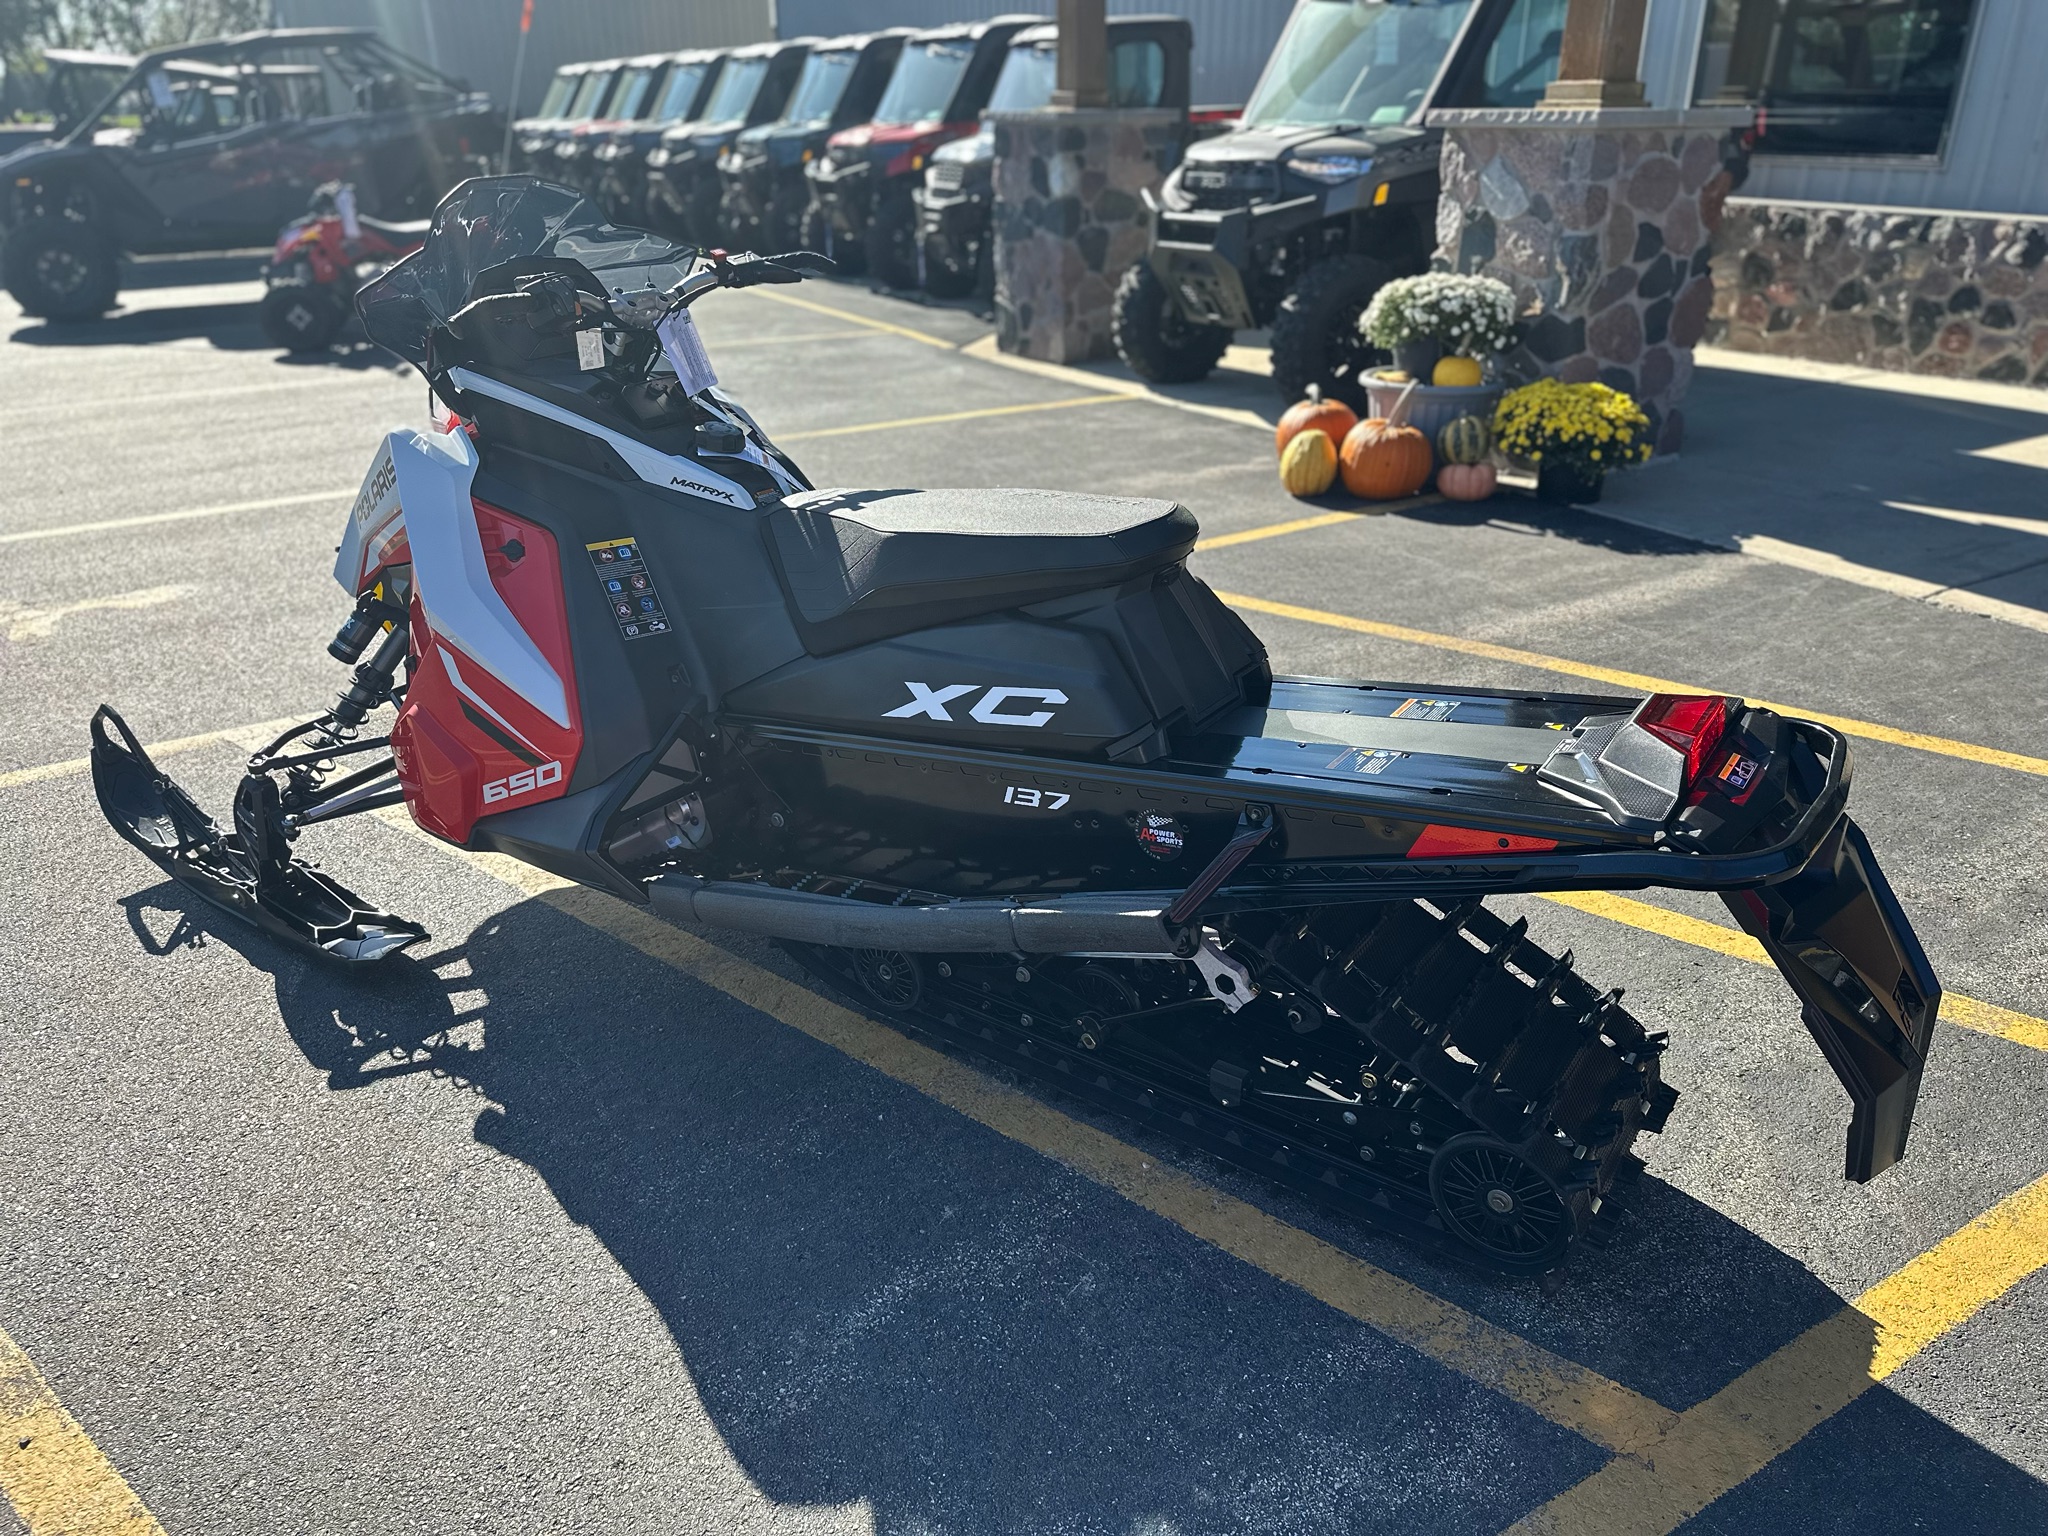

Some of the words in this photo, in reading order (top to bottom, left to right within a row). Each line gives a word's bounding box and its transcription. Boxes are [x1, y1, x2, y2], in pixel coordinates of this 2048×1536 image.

[356, 456, 397, 529] POLARIS
[670, 476, 735, 504] MATRYX
[881, 681, 1070, 728] XC
[482, 760, 562, 804] 650
[1003, 786, 1071, 811] 137
[1140, 827, 1157, 842] A+
[1149, 828, 1175, 839] POWER
[1156, 836, 1184, 846] SPORTS
